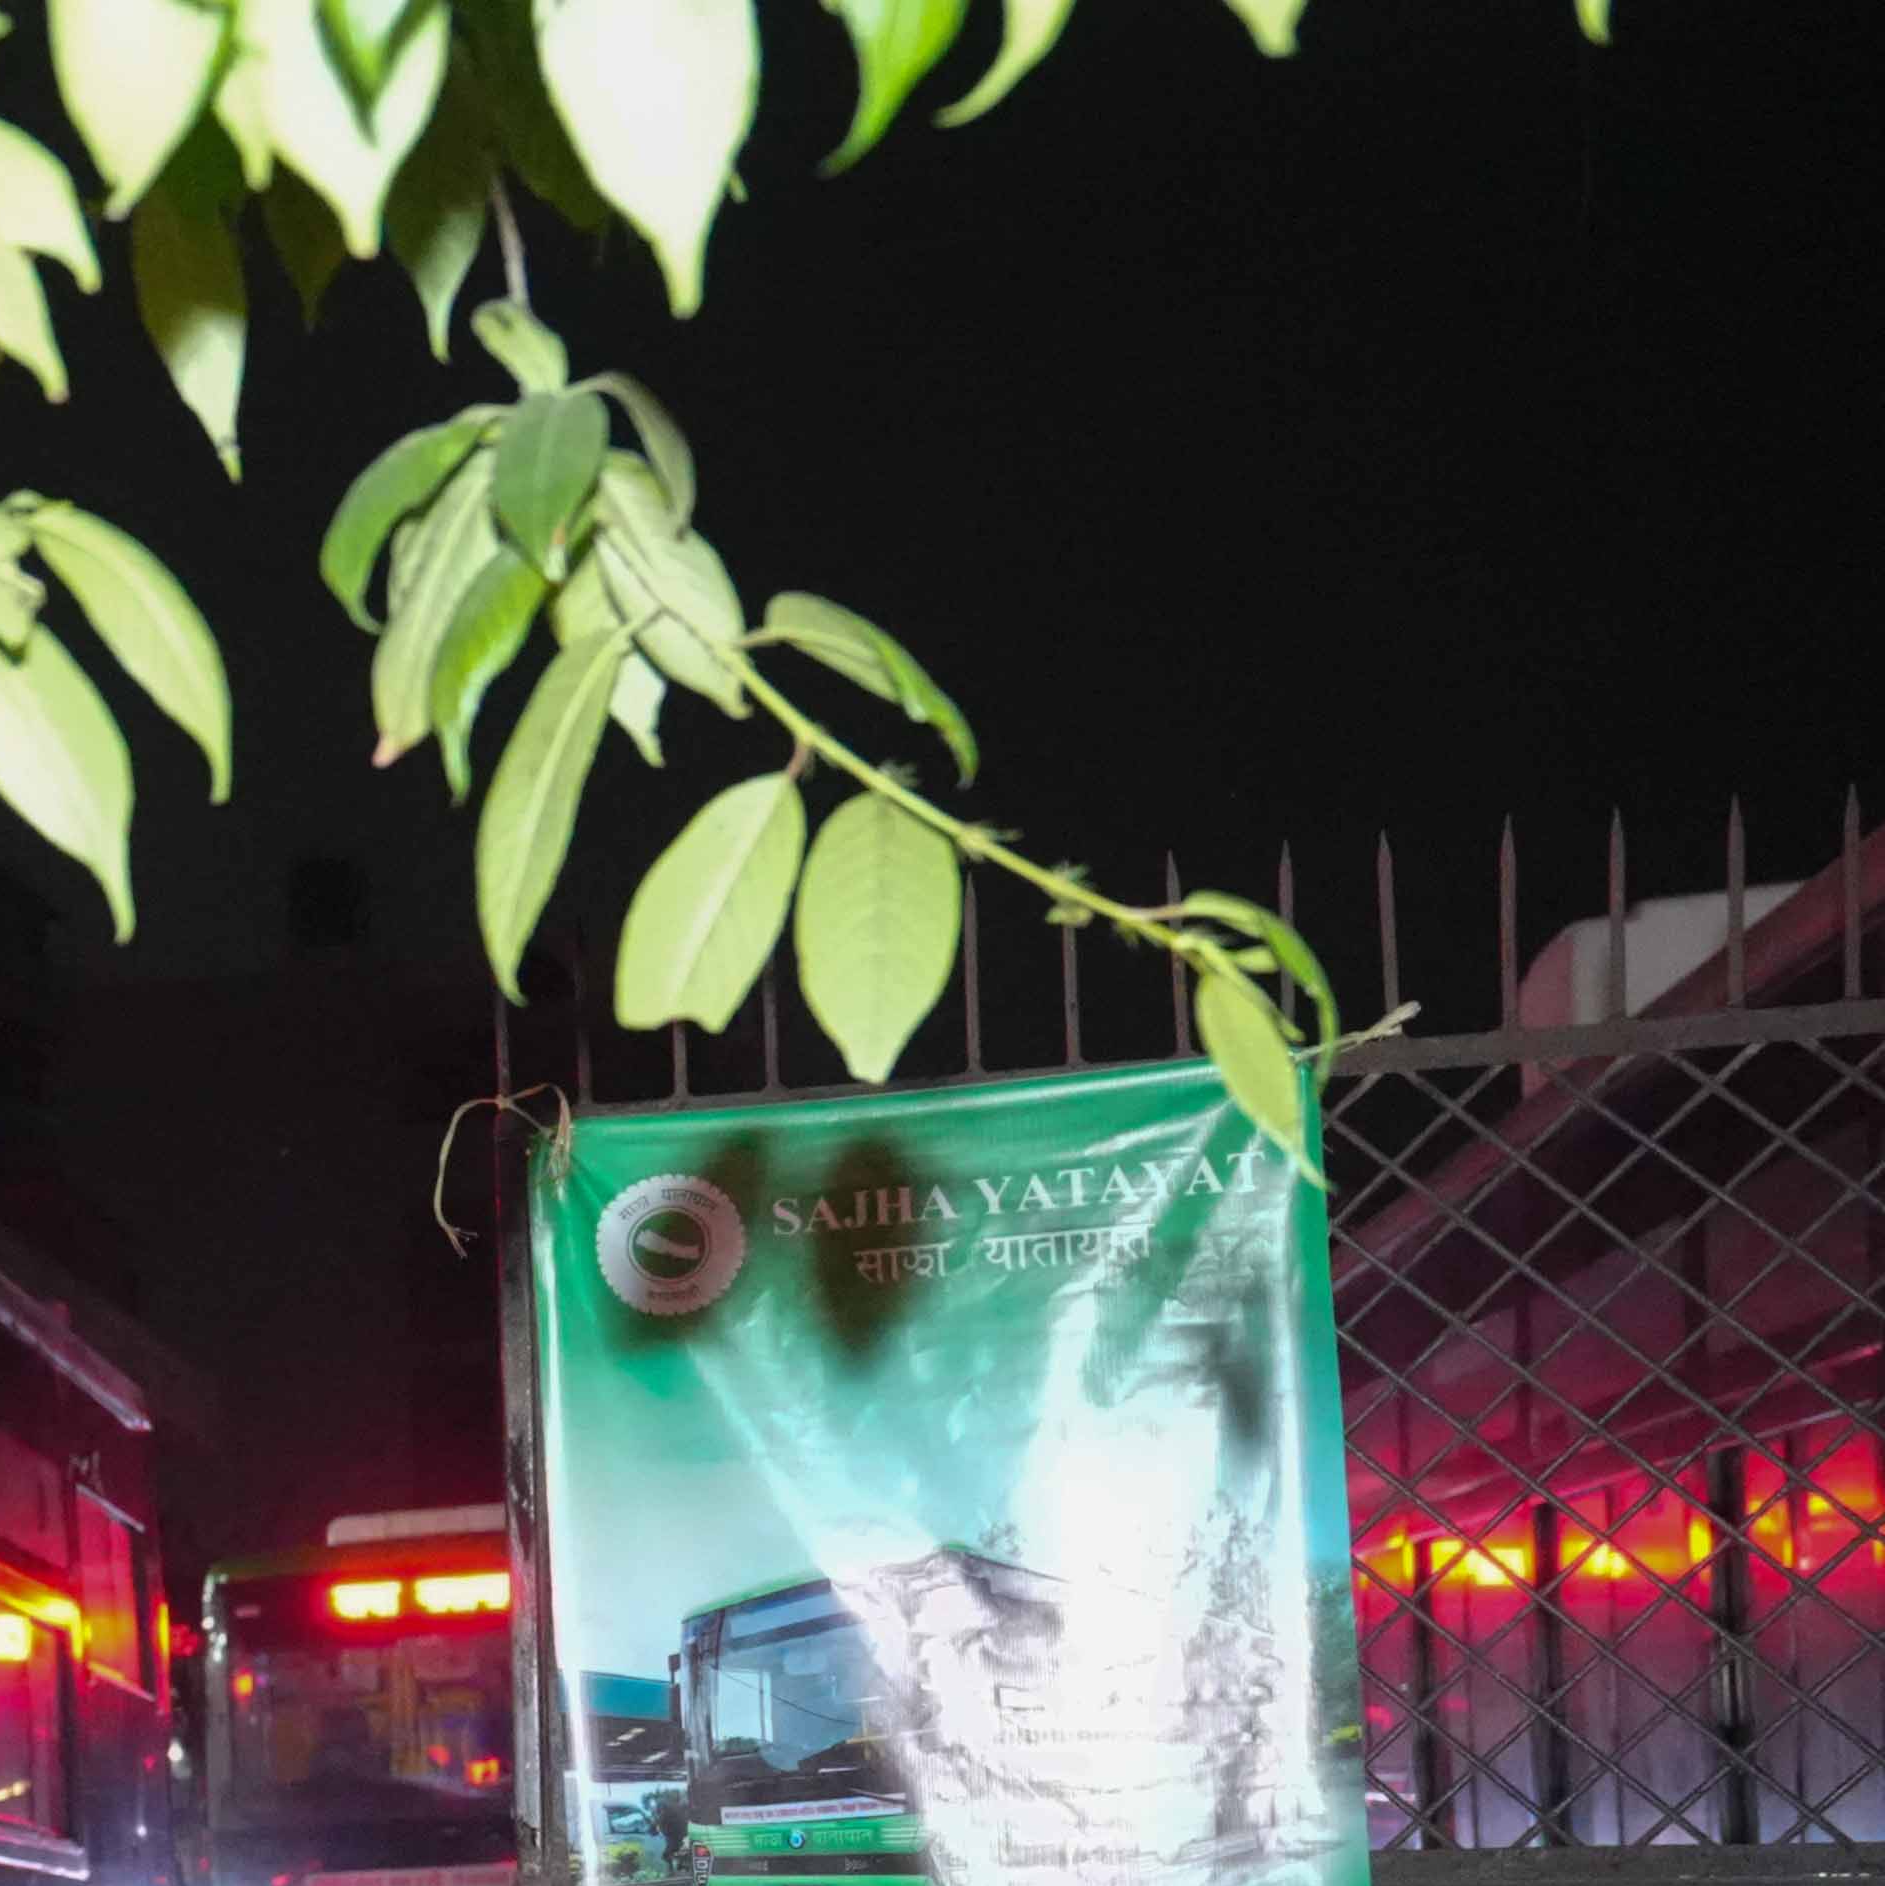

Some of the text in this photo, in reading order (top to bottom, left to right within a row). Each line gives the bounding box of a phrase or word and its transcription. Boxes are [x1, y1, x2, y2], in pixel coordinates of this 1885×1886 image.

[772, 1151, 1266, 1236] SAJHA YATAYAT
[983, 1221, 1155, 1271] यातायात
